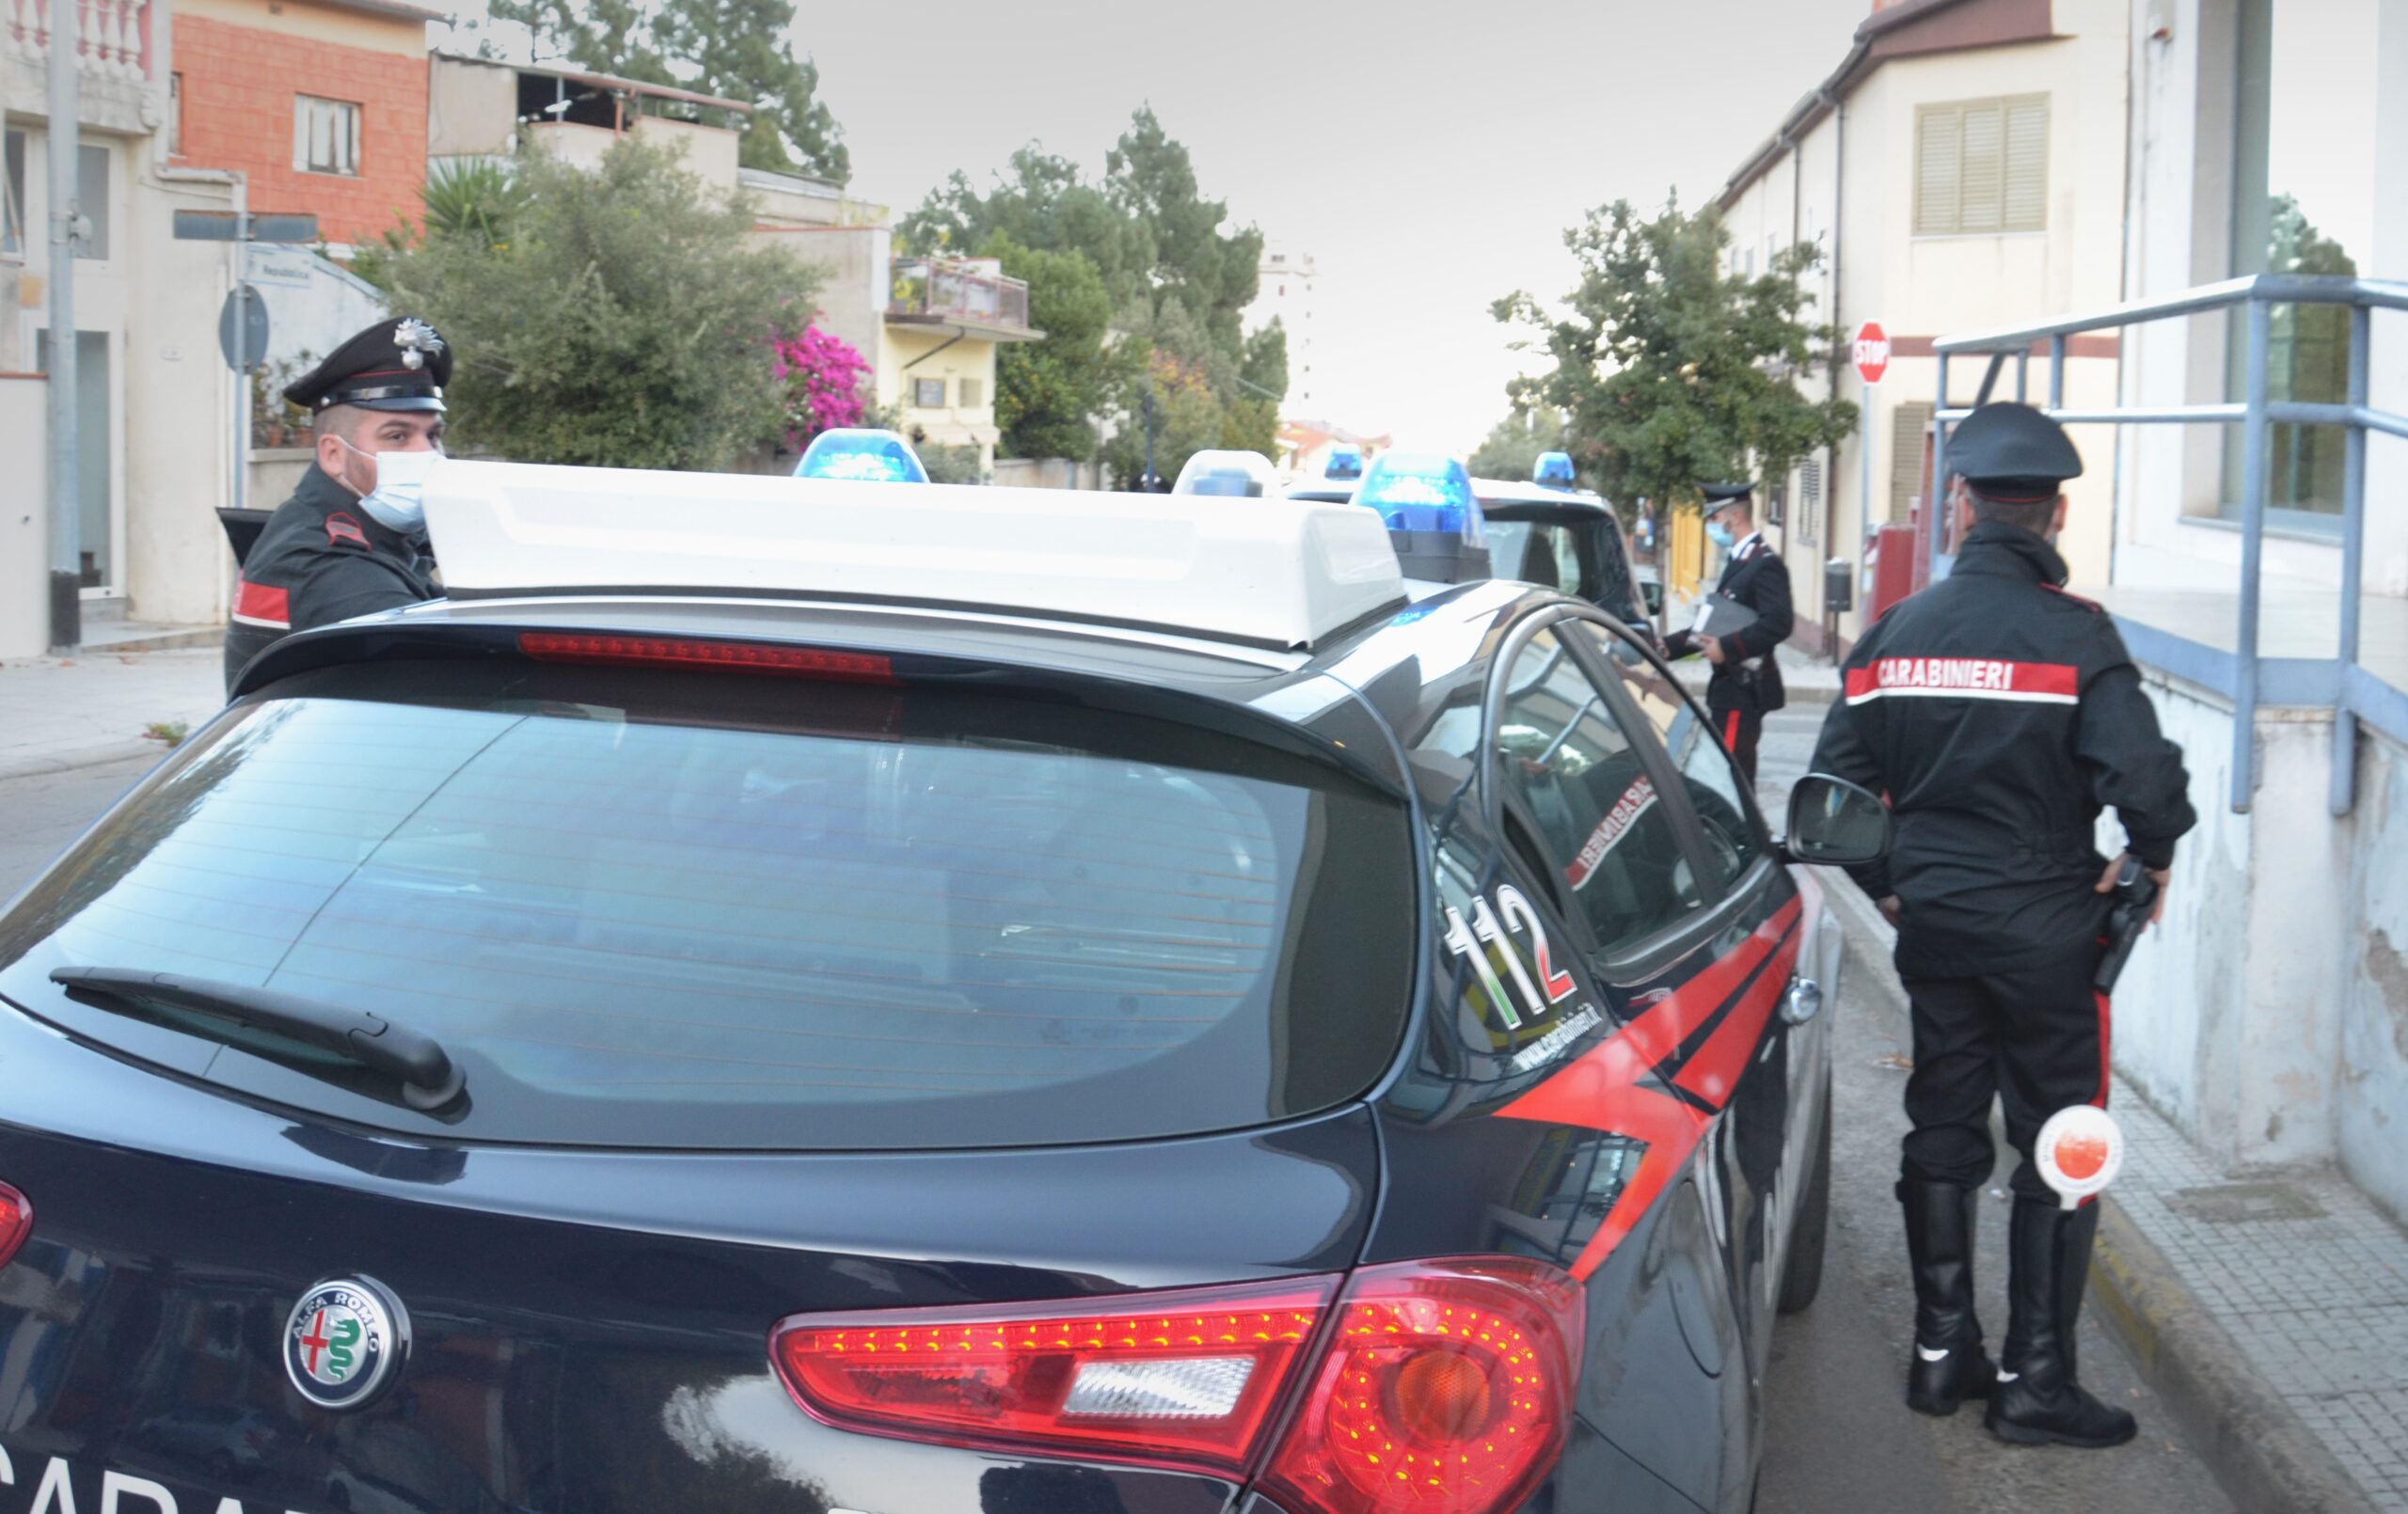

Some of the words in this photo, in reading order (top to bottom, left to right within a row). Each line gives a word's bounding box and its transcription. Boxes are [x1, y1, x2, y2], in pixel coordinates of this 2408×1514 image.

[1854, 339, 1889, 365] STOP
[1877, 659, 2014, 690] CARABINIERI
[1444, 884, 1578, 1031] 112
[293, 1296, 328, 1340] ALFA
[334, 1292, 380, 1352] ROMEO
